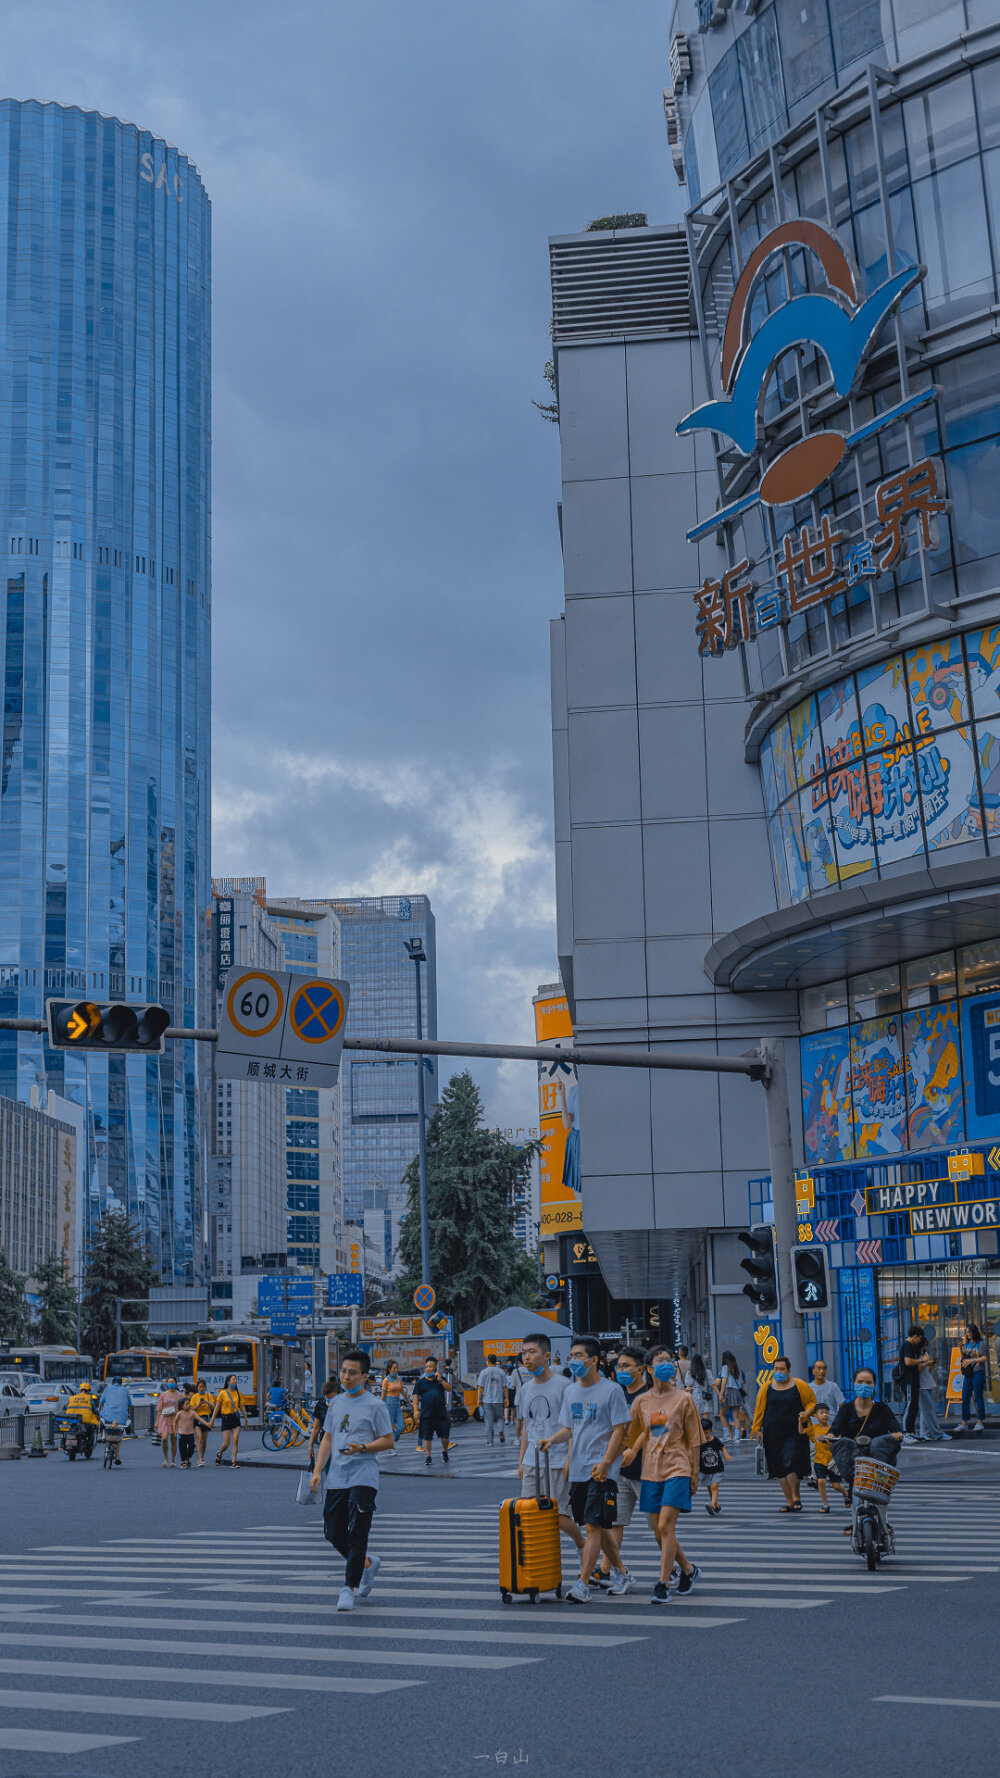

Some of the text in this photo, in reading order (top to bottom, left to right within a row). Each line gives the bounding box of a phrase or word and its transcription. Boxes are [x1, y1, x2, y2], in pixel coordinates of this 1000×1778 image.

[851, 708, 936, 769] BIG SALE
[240, 991, 270, 1019] 60
[246, 1060, 309, 1082] 顺城大街
[873, 1057, 889, 1074] BIG
[879, 1182, 940, 1208] HAPPY
